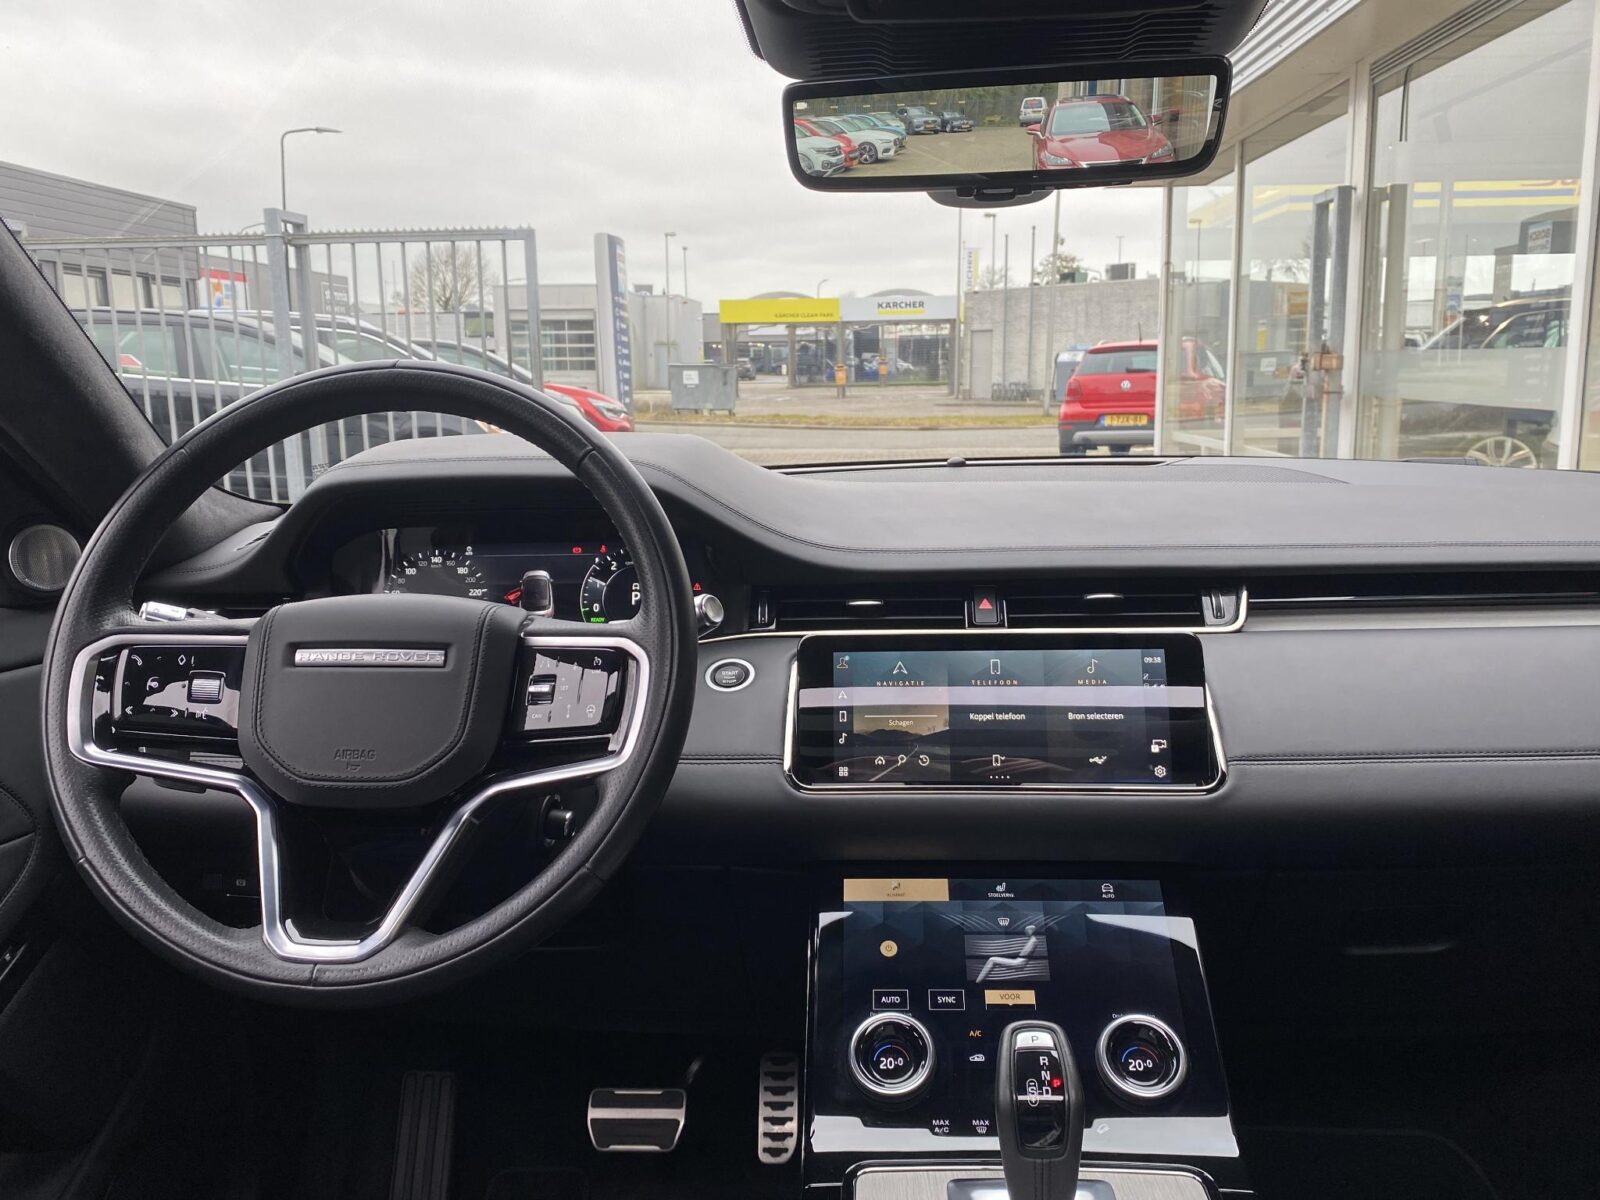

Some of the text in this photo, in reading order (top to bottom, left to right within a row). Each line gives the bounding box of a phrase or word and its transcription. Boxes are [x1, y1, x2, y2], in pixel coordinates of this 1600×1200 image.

[610, 562, 617, 570] 2
[405, 567, 417, 575] 100
[631, 592, 640, 605] P
[593, 604, 600, 612] 0
[300, 651, 441, 662] RANGE ROVER
[969, 712, 1026, 722] Koppel telefoon
[1068, 712, 1124, 720] Bron selecteren
[888, 719, 914, 727] Schagen
[334, 748, 377, 760] AIRBAG
[999, 993, 1021, 1001] VOOR
[1031, 1035, 1039, 1043] P
[1039, 1056, 1049, 1066] R
[1041, 1070, 1051, 1081] N
[1052, 1079, 1061, 1088] P
[1028, 1086, 1038, 1097] S
[1042, 1086, 1052, 1096] D
